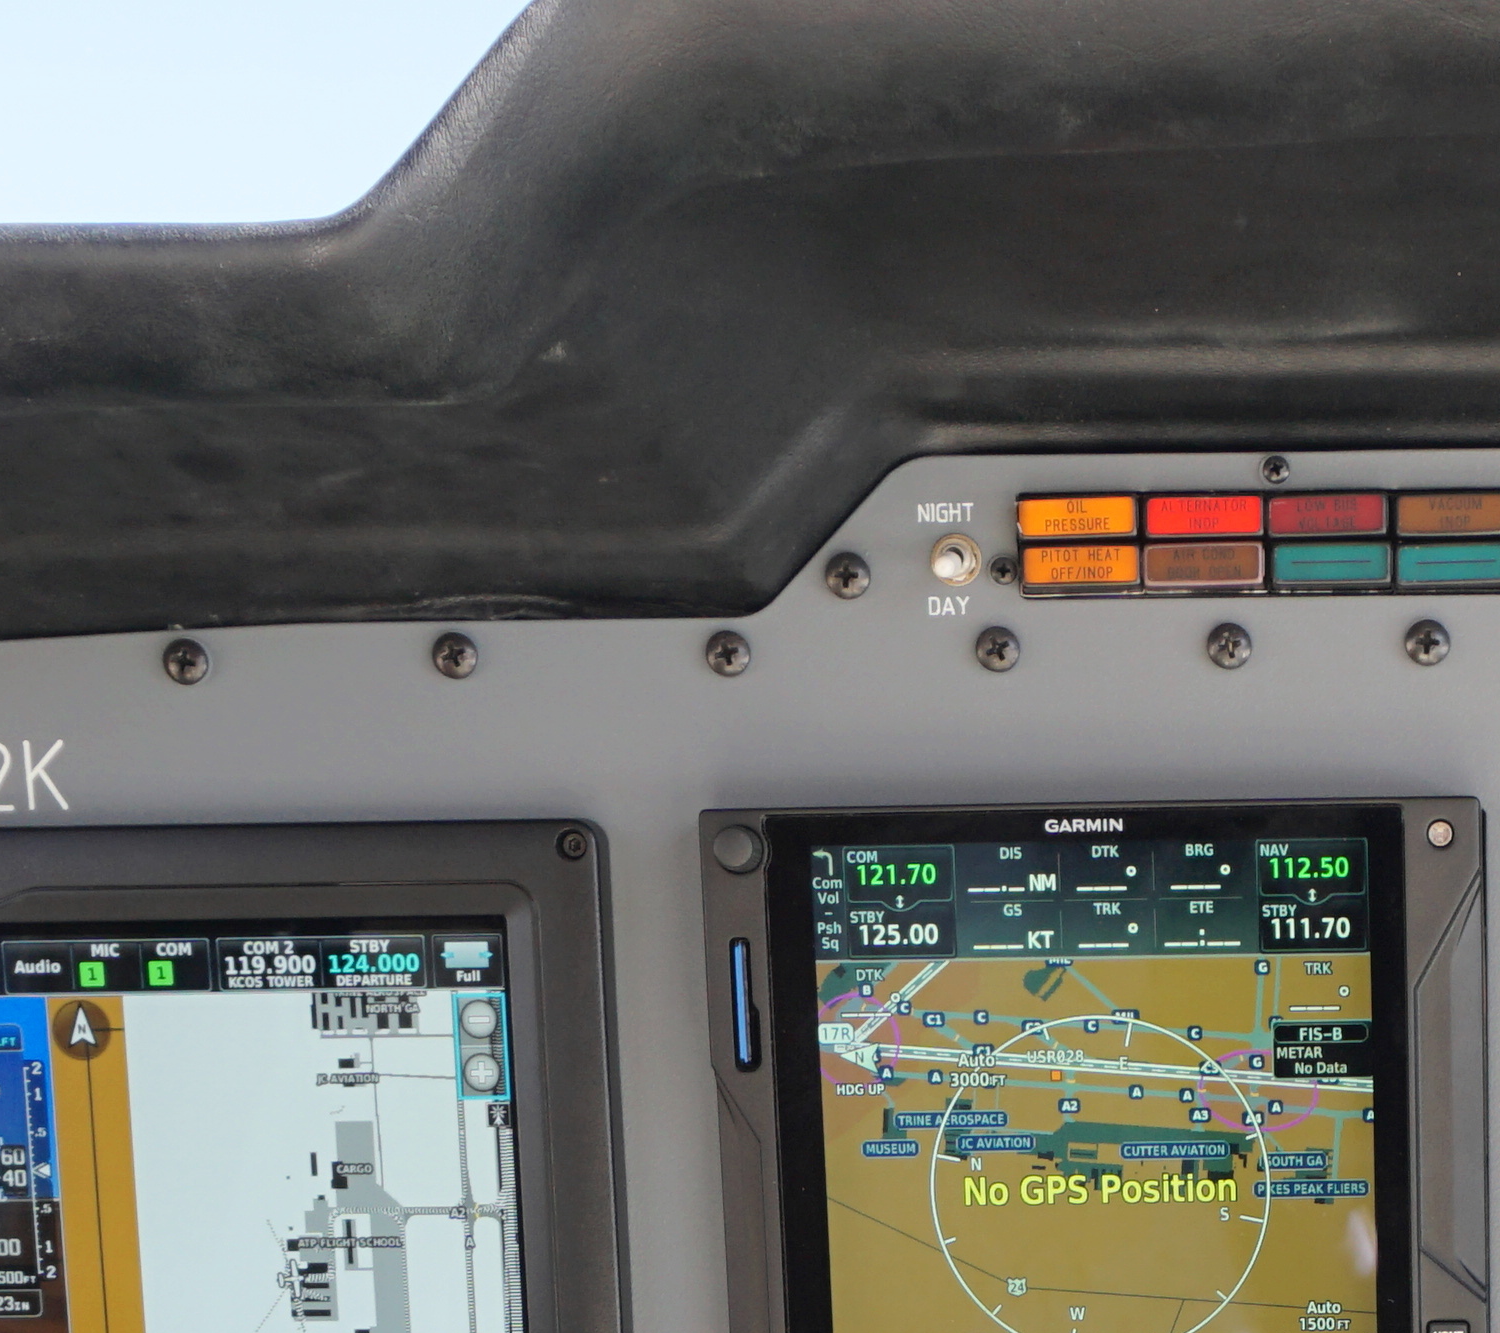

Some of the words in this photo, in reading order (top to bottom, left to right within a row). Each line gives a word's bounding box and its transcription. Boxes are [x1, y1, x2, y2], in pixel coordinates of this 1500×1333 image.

[917, 502, 974, 523] NIGHT
[1066, 500, 1087, 513] OIL
[1045, 517, 1110, 532] PRESSURE
[1041, 548, 1080, 562] PITOT
[1088, 548, 1120, 561] HEAT
[1051, 565, 1113, 578] OFF/INOP
[928, 596, 969, 615] DAY
[1044, 818, 1123, 833] GARMIN
[856, 864, 936, 886] 121.70
[1270, 857, 1349, 879] 112.50
[859, 924, 938, 946] 125.00
[1271, 917, 1350, 940] 111.70
[14, 959, 61, 976] Audio
[225, 956, 316, 975] 119.900
[329, 955, 419, 974] 124.000
[336, 974, 412, 986] DEPARTURE
[1124, 1144, 1167, 1156] CUTTER
[1171, 1143, 1226, 1157] AVIATION
[964, 1176, 1008, 1206] No
[1020, 1176, 1087, 1205] GPS
[1100, 1172, 1237, 1204] Position
